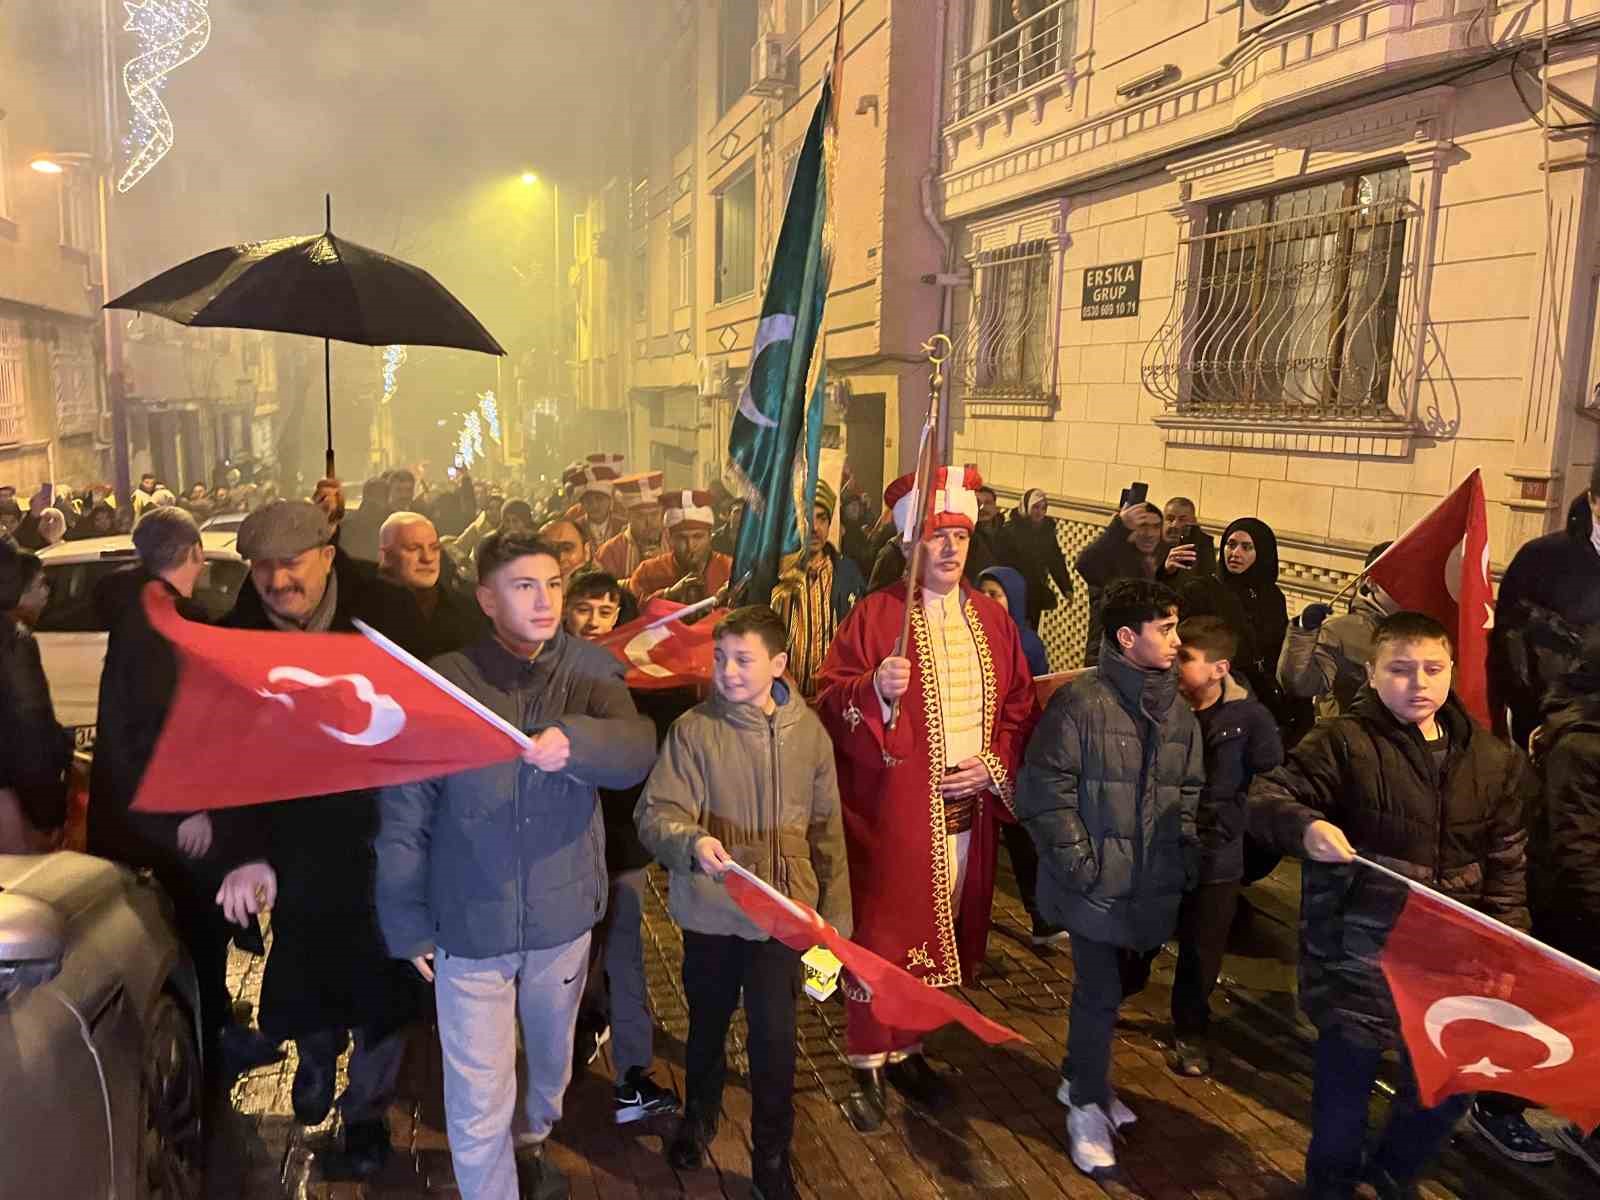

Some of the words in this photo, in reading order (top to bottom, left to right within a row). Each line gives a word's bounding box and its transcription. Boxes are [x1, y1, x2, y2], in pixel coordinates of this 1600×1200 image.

[1087, 264, 1135, 287] ERSKA
[1093, 285, 1126, 302] GRUP
[1116, 302, 1126, 315] 10
[1127, 301, 1136, 313] 71
